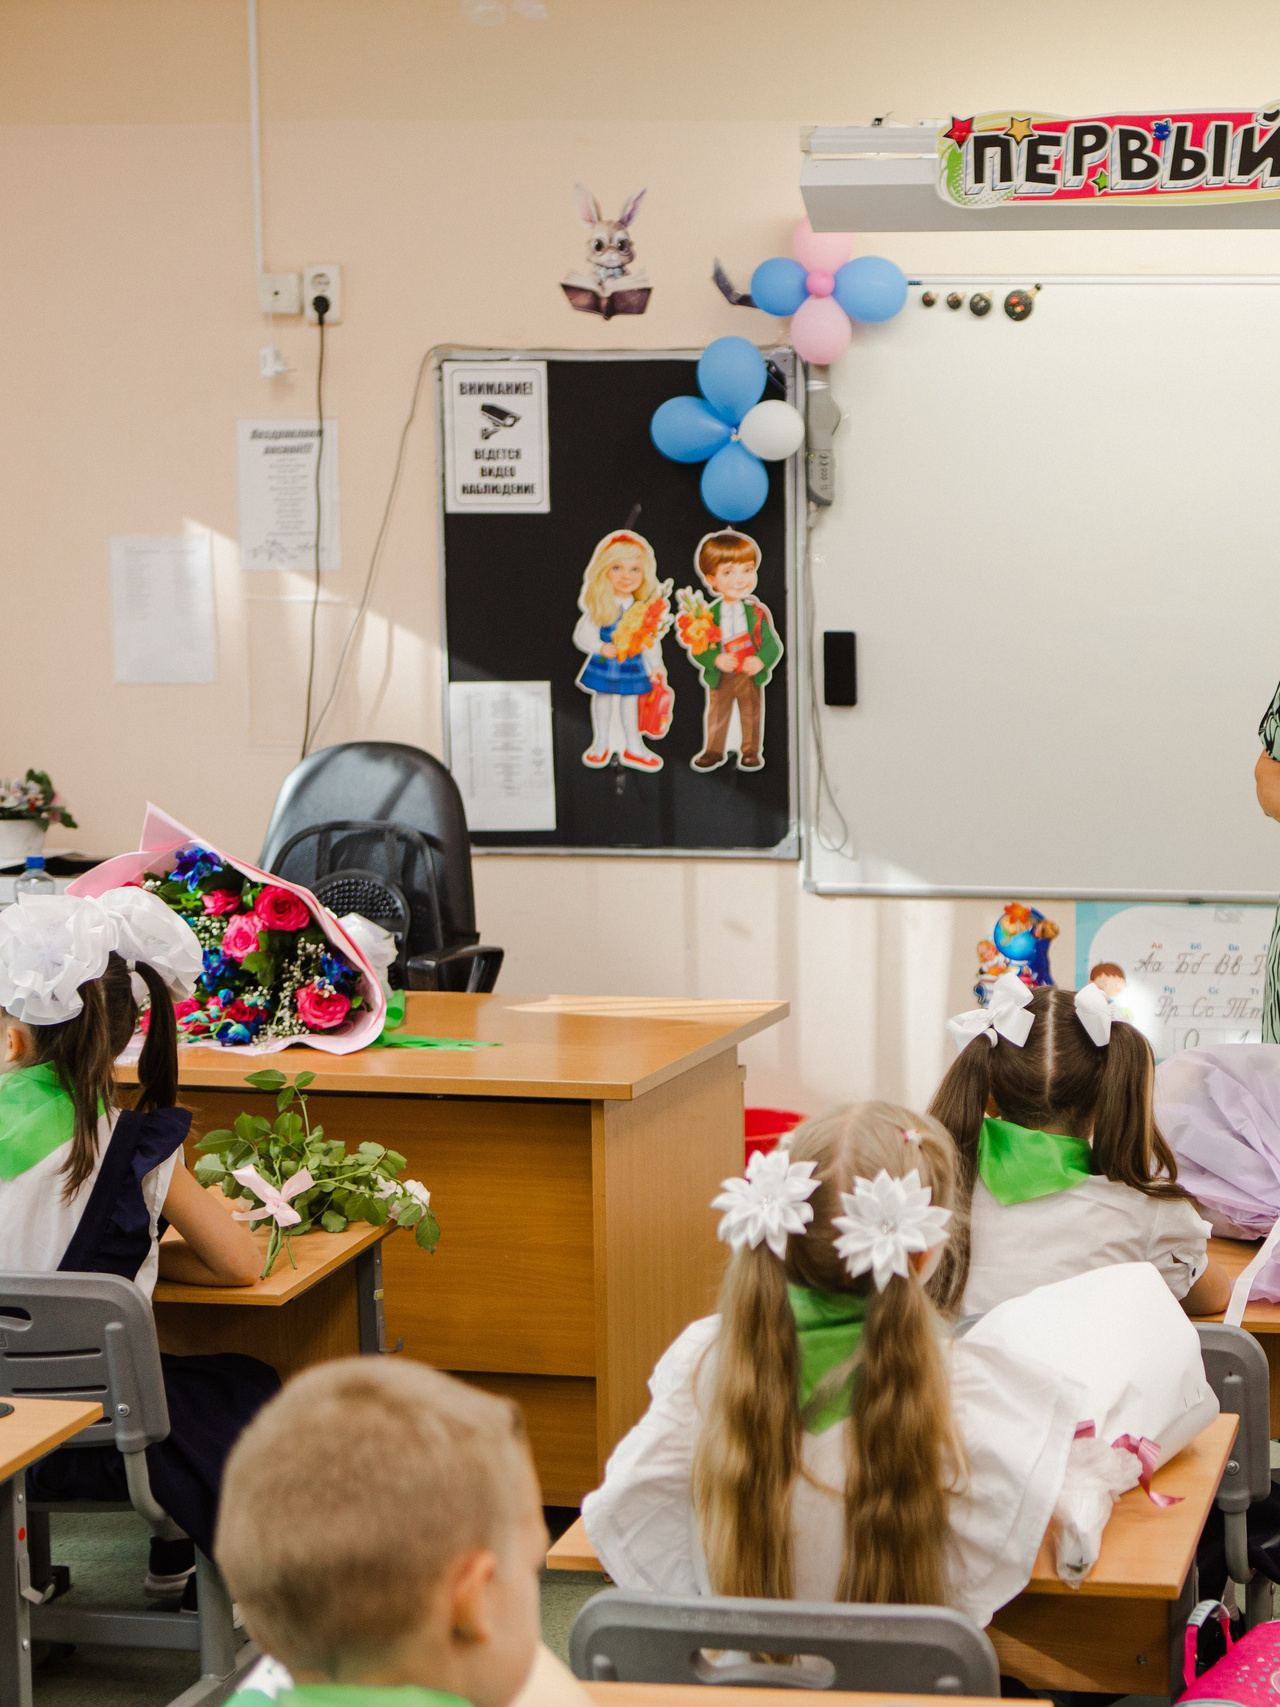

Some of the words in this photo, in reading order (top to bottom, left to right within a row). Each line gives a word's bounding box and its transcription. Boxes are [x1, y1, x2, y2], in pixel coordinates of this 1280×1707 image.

[460, 381, 534, 396] ВНИМАНИЕ!
[474, 448, 522, 460] ВЕДЕТСЯ
[480, 466, 516, 478] ВИДЕО
[462, 483, 536, 495] НАБЛЮДЕНИЕ
